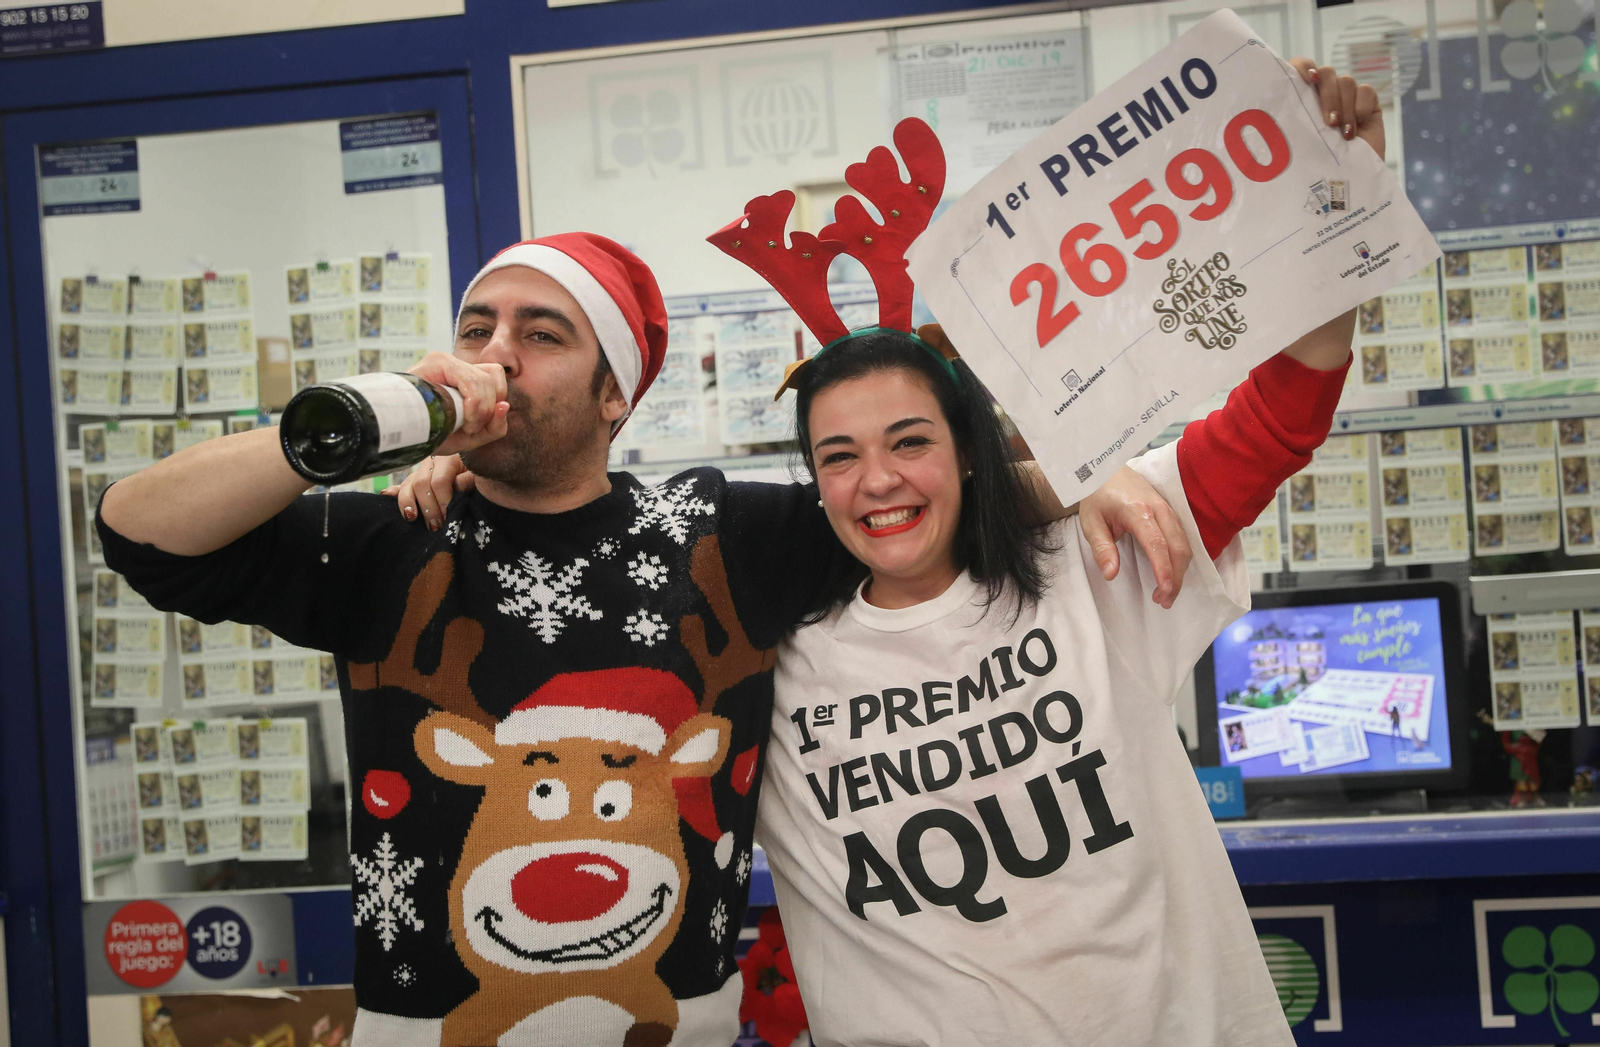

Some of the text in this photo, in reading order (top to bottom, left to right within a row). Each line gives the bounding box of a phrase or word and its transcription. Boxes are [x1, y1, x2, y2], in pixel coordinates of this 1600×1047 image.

[0, 4, 89, 27] 902 15 15 20
[1039, 57, 1218, 198] PREMIO
[1009, 108, 1291, 348] 26590
[1302, 200, 1392, 255] SORTEO EXTRAORDINARIO DE NAVIDAD
[1324, 224, 1333, 233] DE
[1332, 206, 1367, 229] DICIEMBRE
[1370, 241, 1400, 262] Apuestas
[1357, 257, 1391, 279] del Estado
[1077, 365, 1106, 395] Nacional
[1088, 425, 1136, 469] Tamarguillo
[1140, 389, 1180, 425] SEVILLA
[1357, 634, 1413, 666] cumple
[790, 628, 1058, 755] 1er PREMIO
[805, 690, 1083, 821] VENDIDO
[842, 740, 1135, 923] AQUÍ
[111, 920, 180, 939] Primera
[191, 919, 242, 949] +18
[108, 935, 184, 957] regla del
[195, 945, 239, 963] años
[118, 954, 175, 974] juego:
